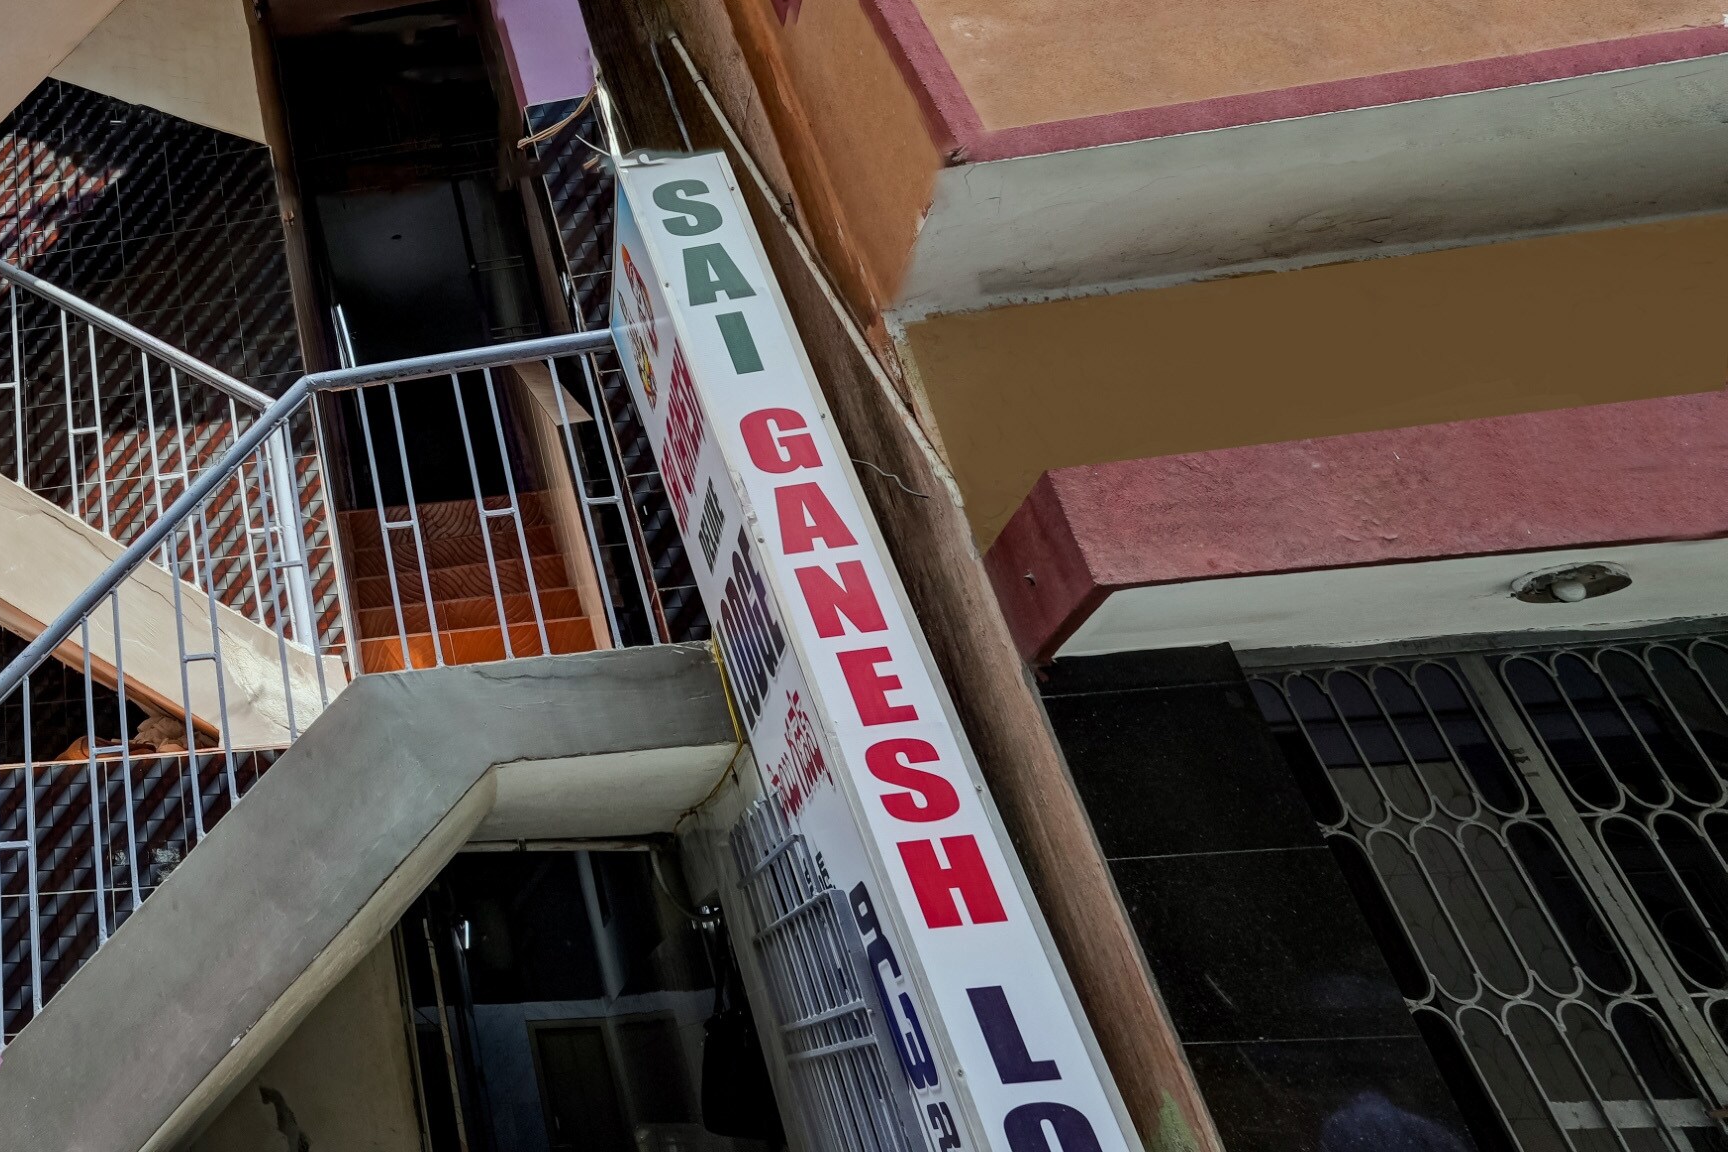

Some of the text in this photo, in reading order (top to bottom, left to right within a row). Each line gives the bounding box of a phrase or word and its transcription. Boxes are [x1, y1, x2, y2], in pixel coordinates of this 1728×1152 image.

[666, 337, 707, 497] GANESH
[651, 178, 765, 375] SAI
[739, 407, 1009, 930] GANESH
[698, 476, 725, 576] DELUXE
[716, 524, 786, 732] LODGE
